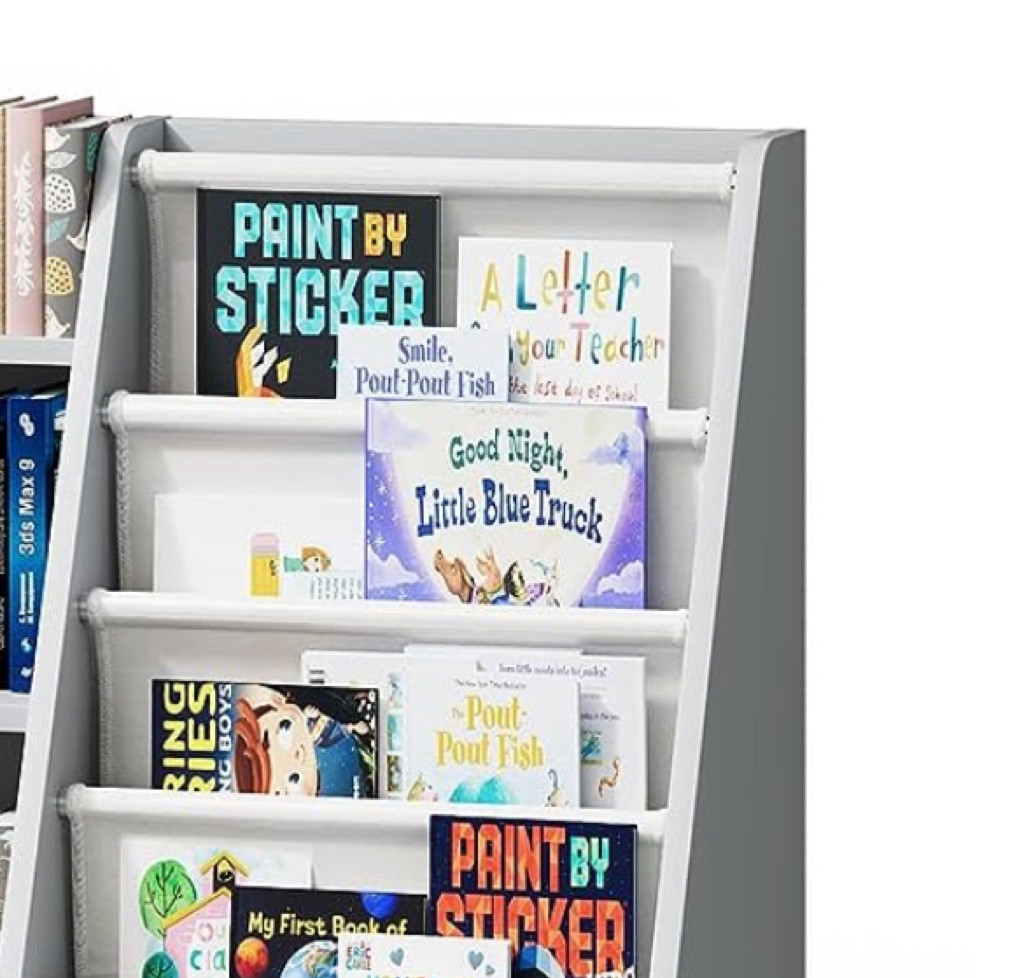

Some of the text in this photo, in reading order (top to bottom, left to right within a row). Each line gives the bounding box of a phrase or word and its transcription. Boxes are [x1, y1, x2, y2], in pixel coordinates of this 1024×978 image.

[233, 202, 407, 259] PAINT BY
[214, 266, 425, 335] STICKER
[481, 250, 641, 315] A Letter
[398, 335, 453, 364] Smile,
[570, 316, 665, 364] Teacher
[354, 365, 495, 398] Pout-Pout Fish
[18, 458, 35, 471] 9
[449, 428, 569, 478] Good Night,
[18, 475, 35, 516] Max
[415, 478, 603, 543] Little Blue Truck
[18, 521, 35, 555] 3ds
[218, 684, 232, 751] BOYS
[436, 731, 544, 770] Pout Fish
[451, 822, 609, 893] PAINT BY
[248, 911, 275, 939] My
[279, 912, 327, 935] First
[332, 915, 380, 935] Book
[436, 892, 625, 978] STICKER
